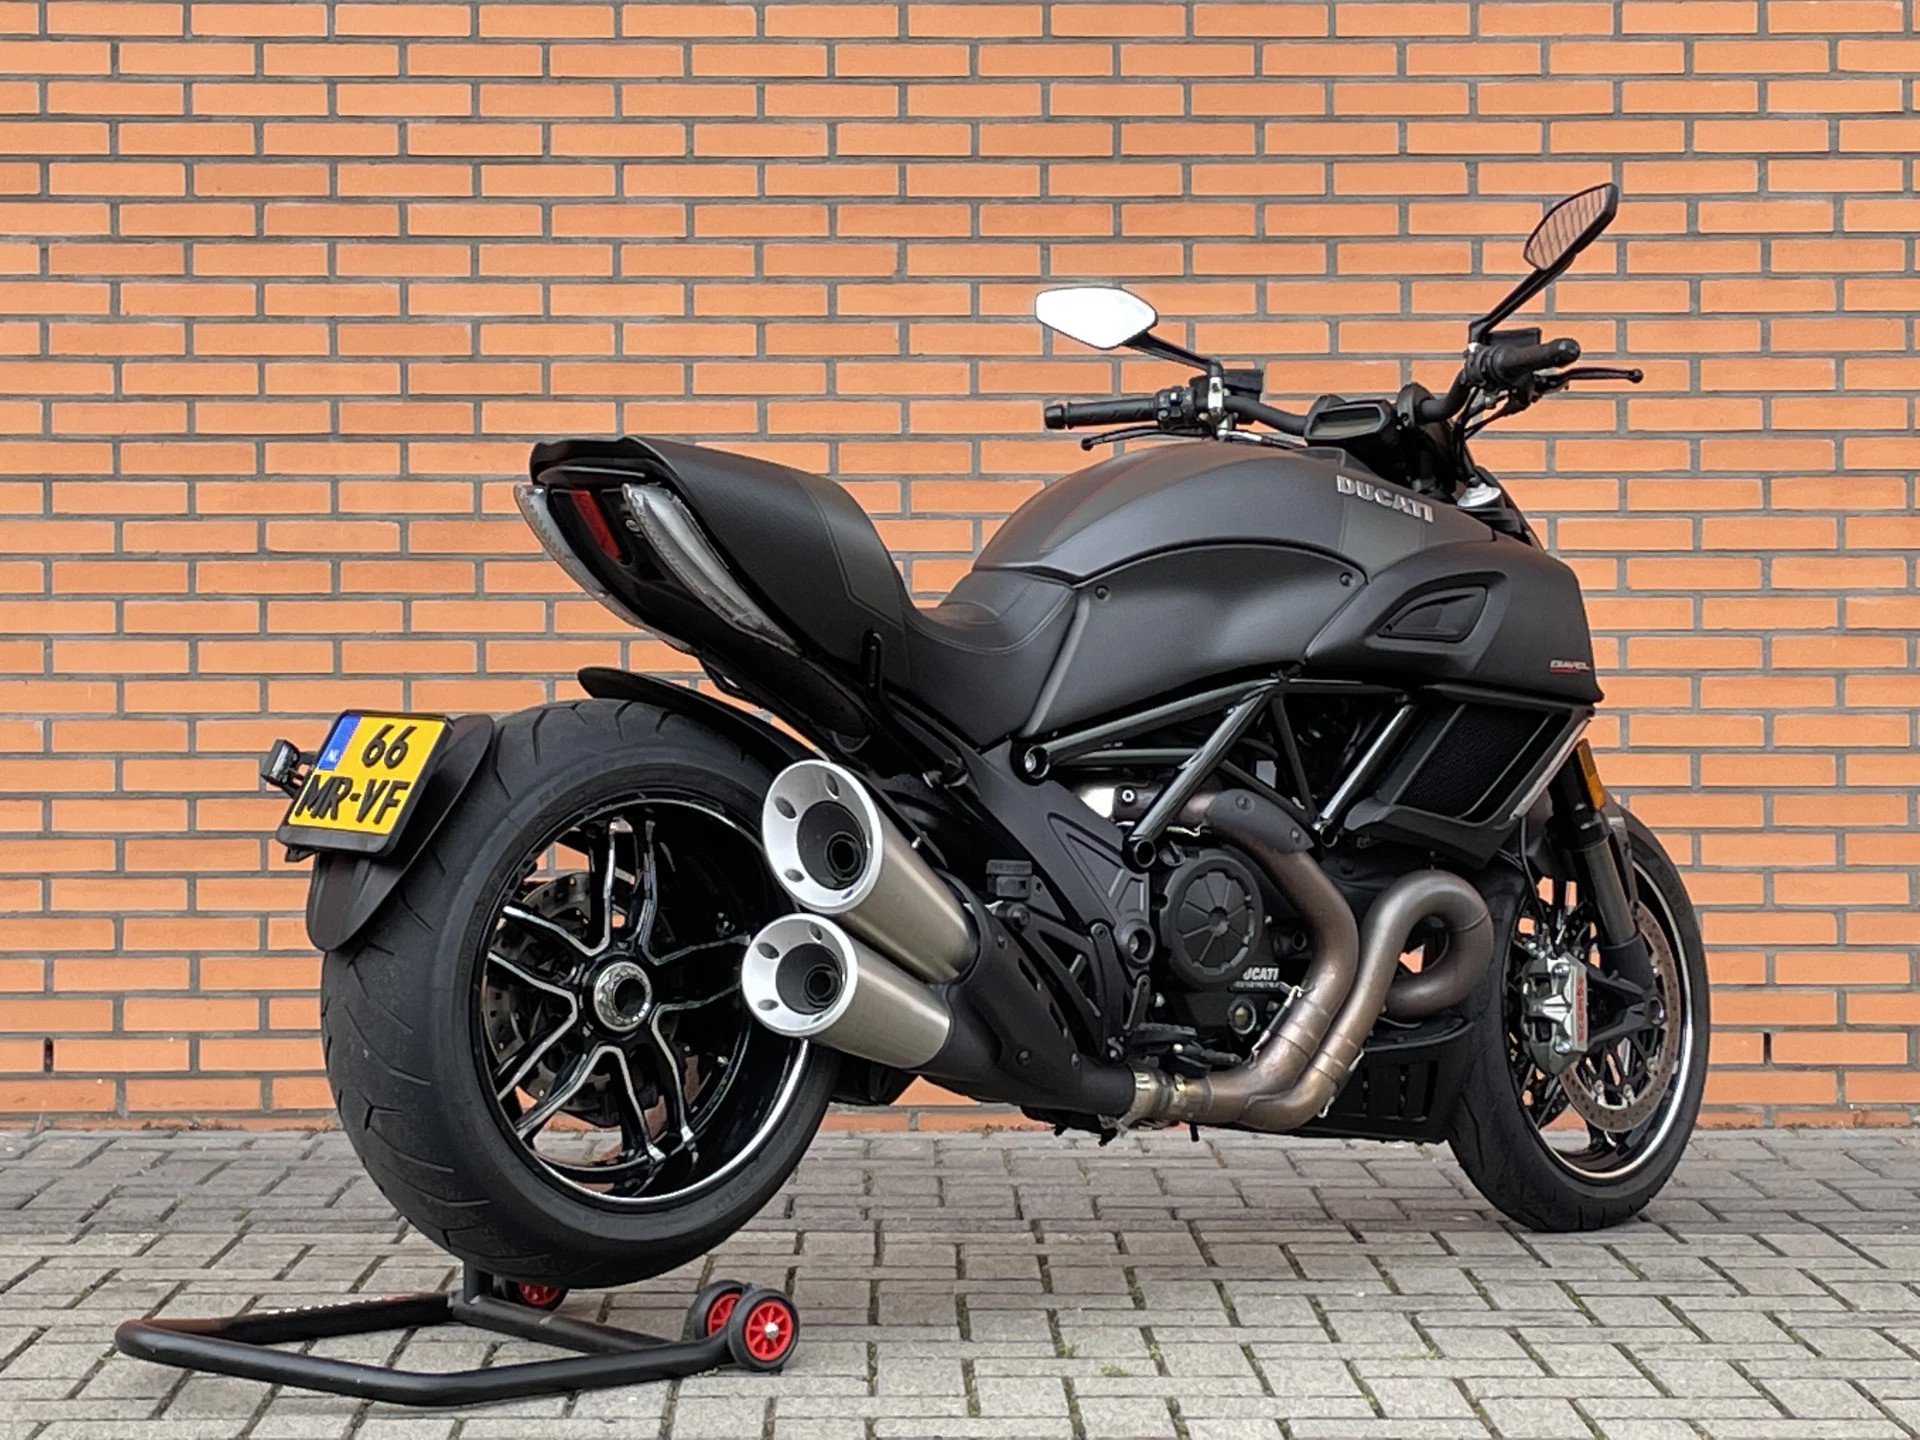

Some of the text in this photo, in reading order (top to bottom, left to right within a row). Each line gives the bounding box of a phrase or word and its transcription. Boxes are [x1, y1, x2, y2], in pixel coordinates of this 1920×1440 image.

[1336, 474, 1434, 523] DUCATI
[362, 724, 417, 769] 66
[294, 774, 411, 825] MR-VF
[1242, 967, 1279, 981] UCATI
